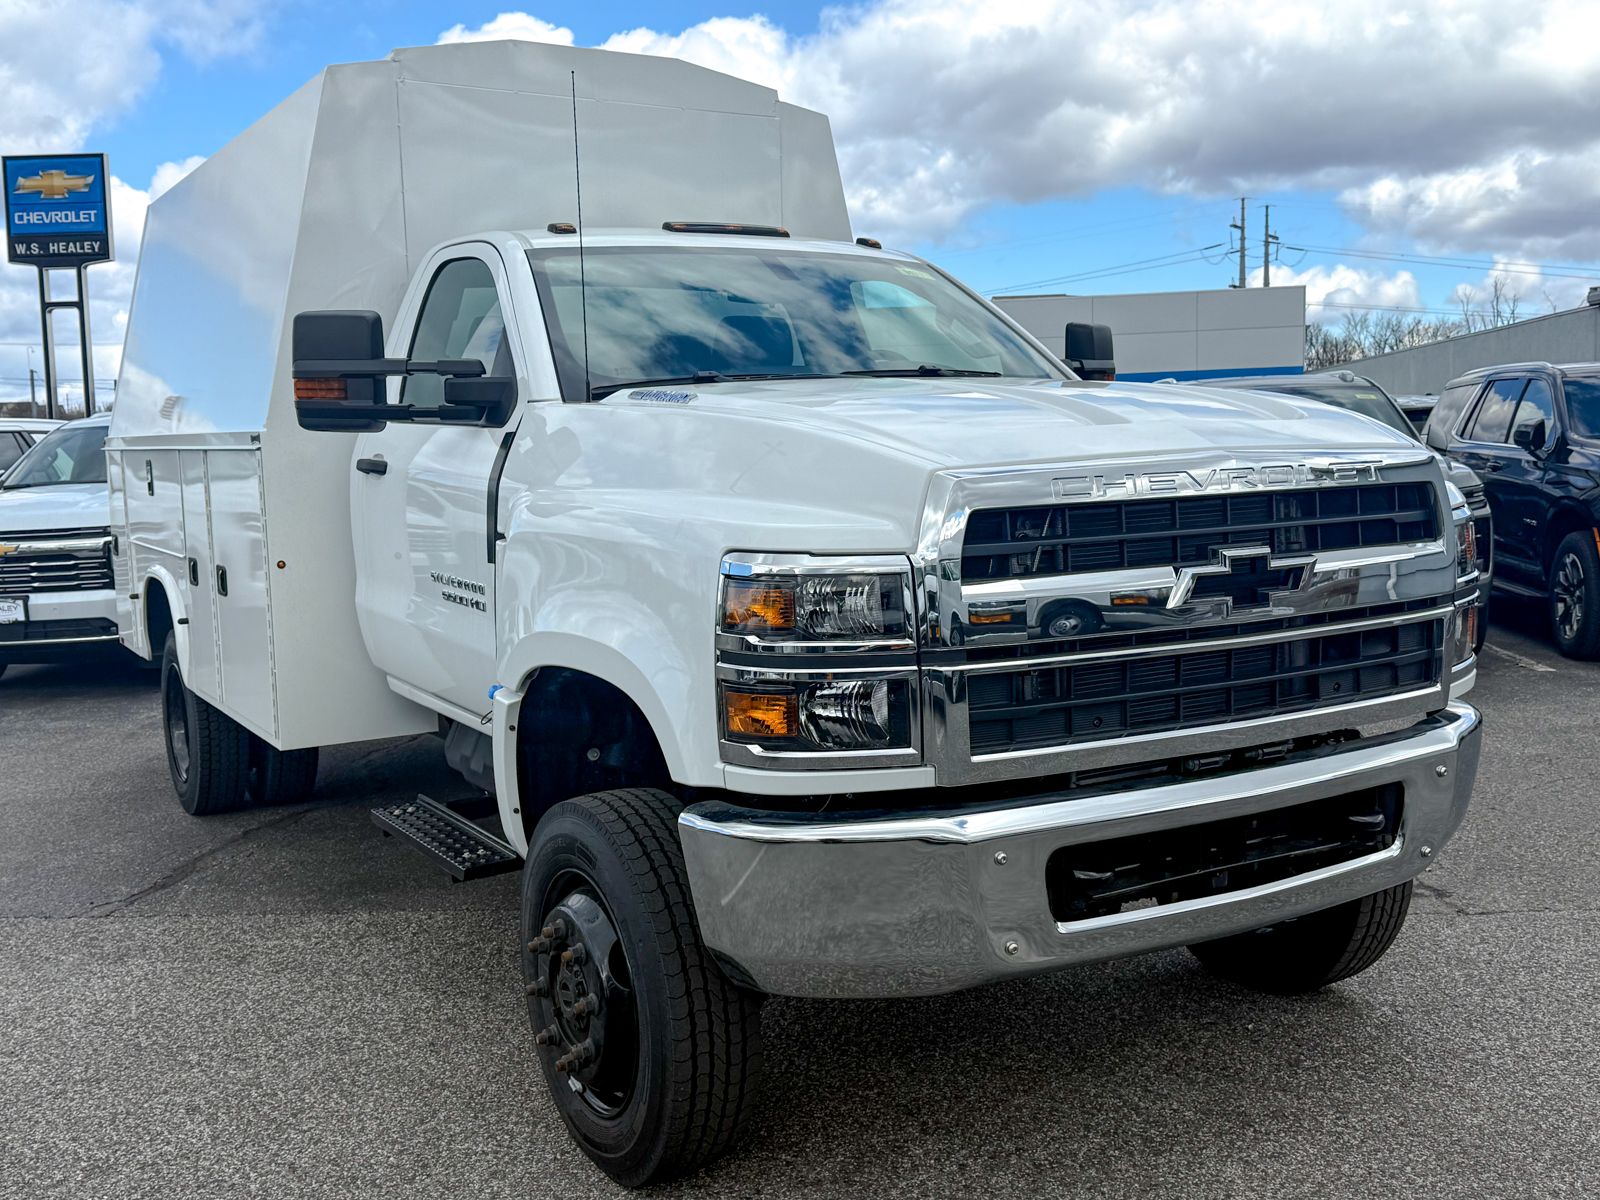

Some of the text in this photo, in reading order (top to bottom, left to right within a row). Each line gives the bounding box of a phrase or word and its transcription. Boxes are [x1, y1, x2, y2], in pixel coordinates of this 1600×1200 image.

[14, 210, 97, 225] CHEVROLET
[15, 241, 101, 254] W.S. HEALEY
[1051, 460, 1384, 500] CHEVROLET
